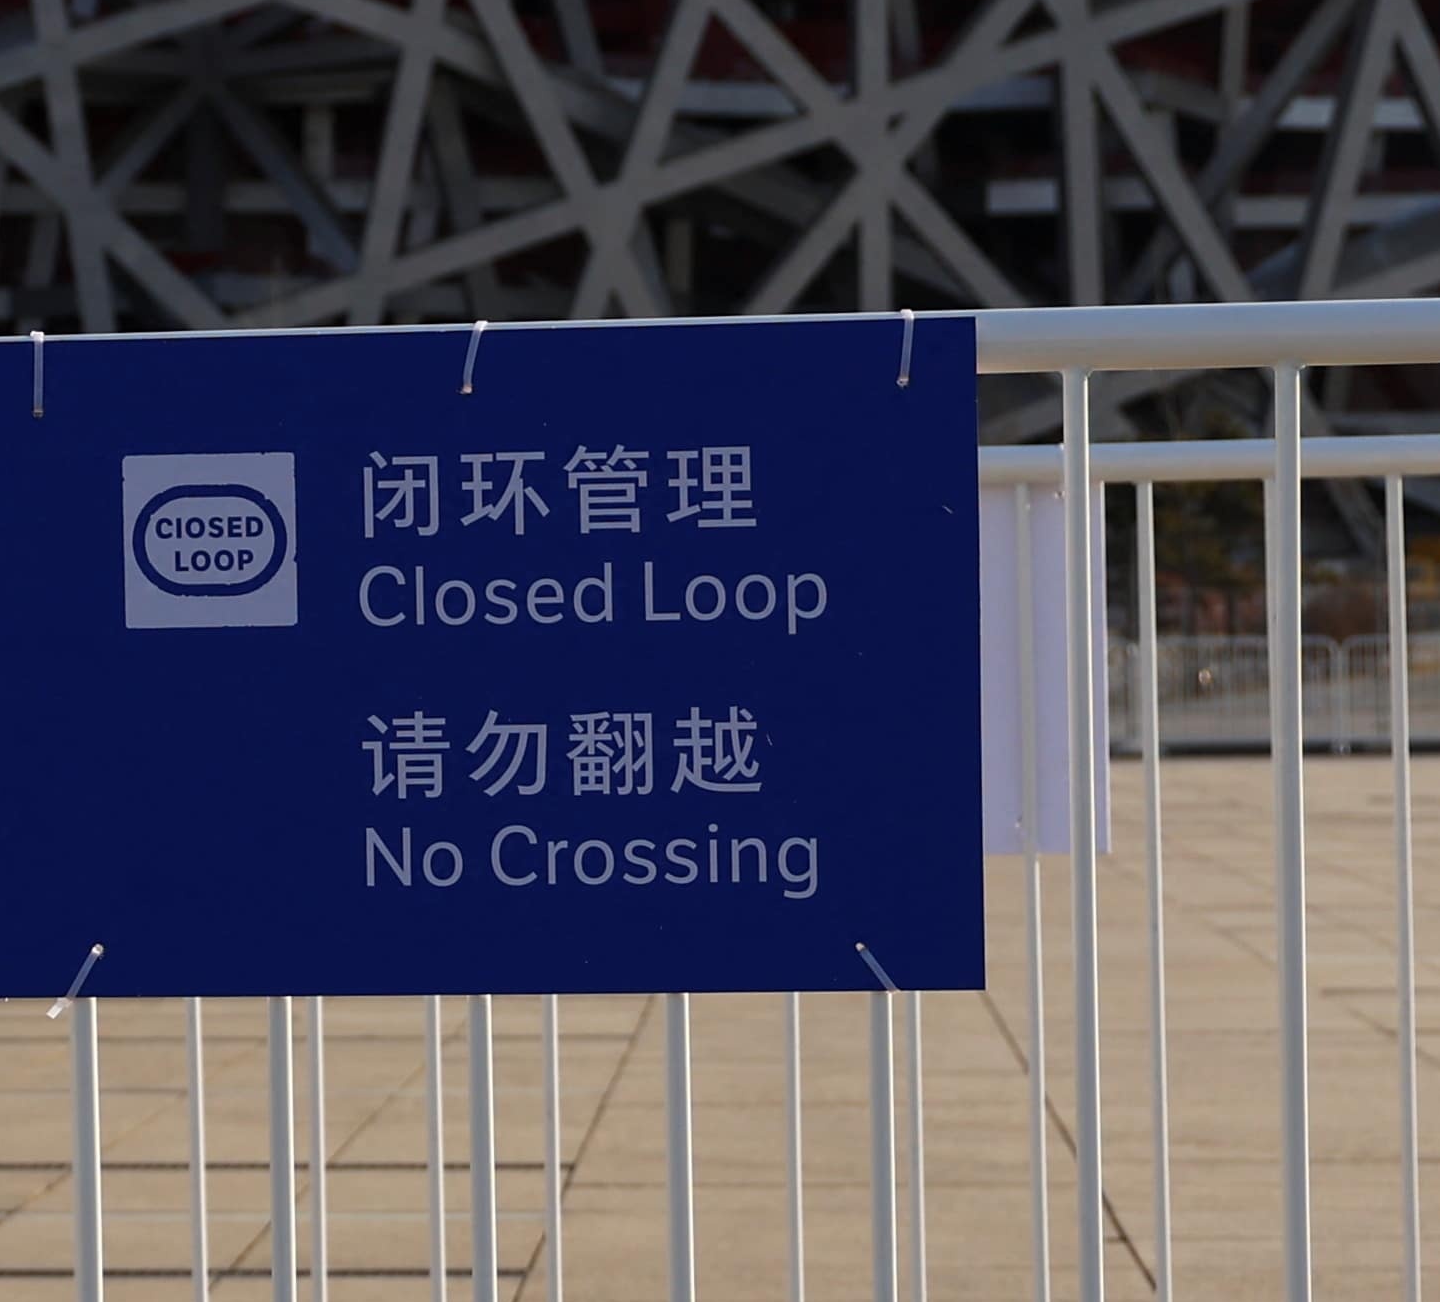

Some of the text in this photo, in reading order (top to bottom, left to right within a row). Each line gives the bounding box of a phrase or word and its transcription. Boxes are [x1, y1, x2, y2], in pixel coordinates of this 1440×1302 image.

[361, 444, 758, 539] 闭环管理
[174, 549, 255, 572] LOOP
[358, 561, 828, 635] Closed Loop
[361, 706, 762, 799] 请勿翻越
[364, 823, 819, 899] No Crossing
